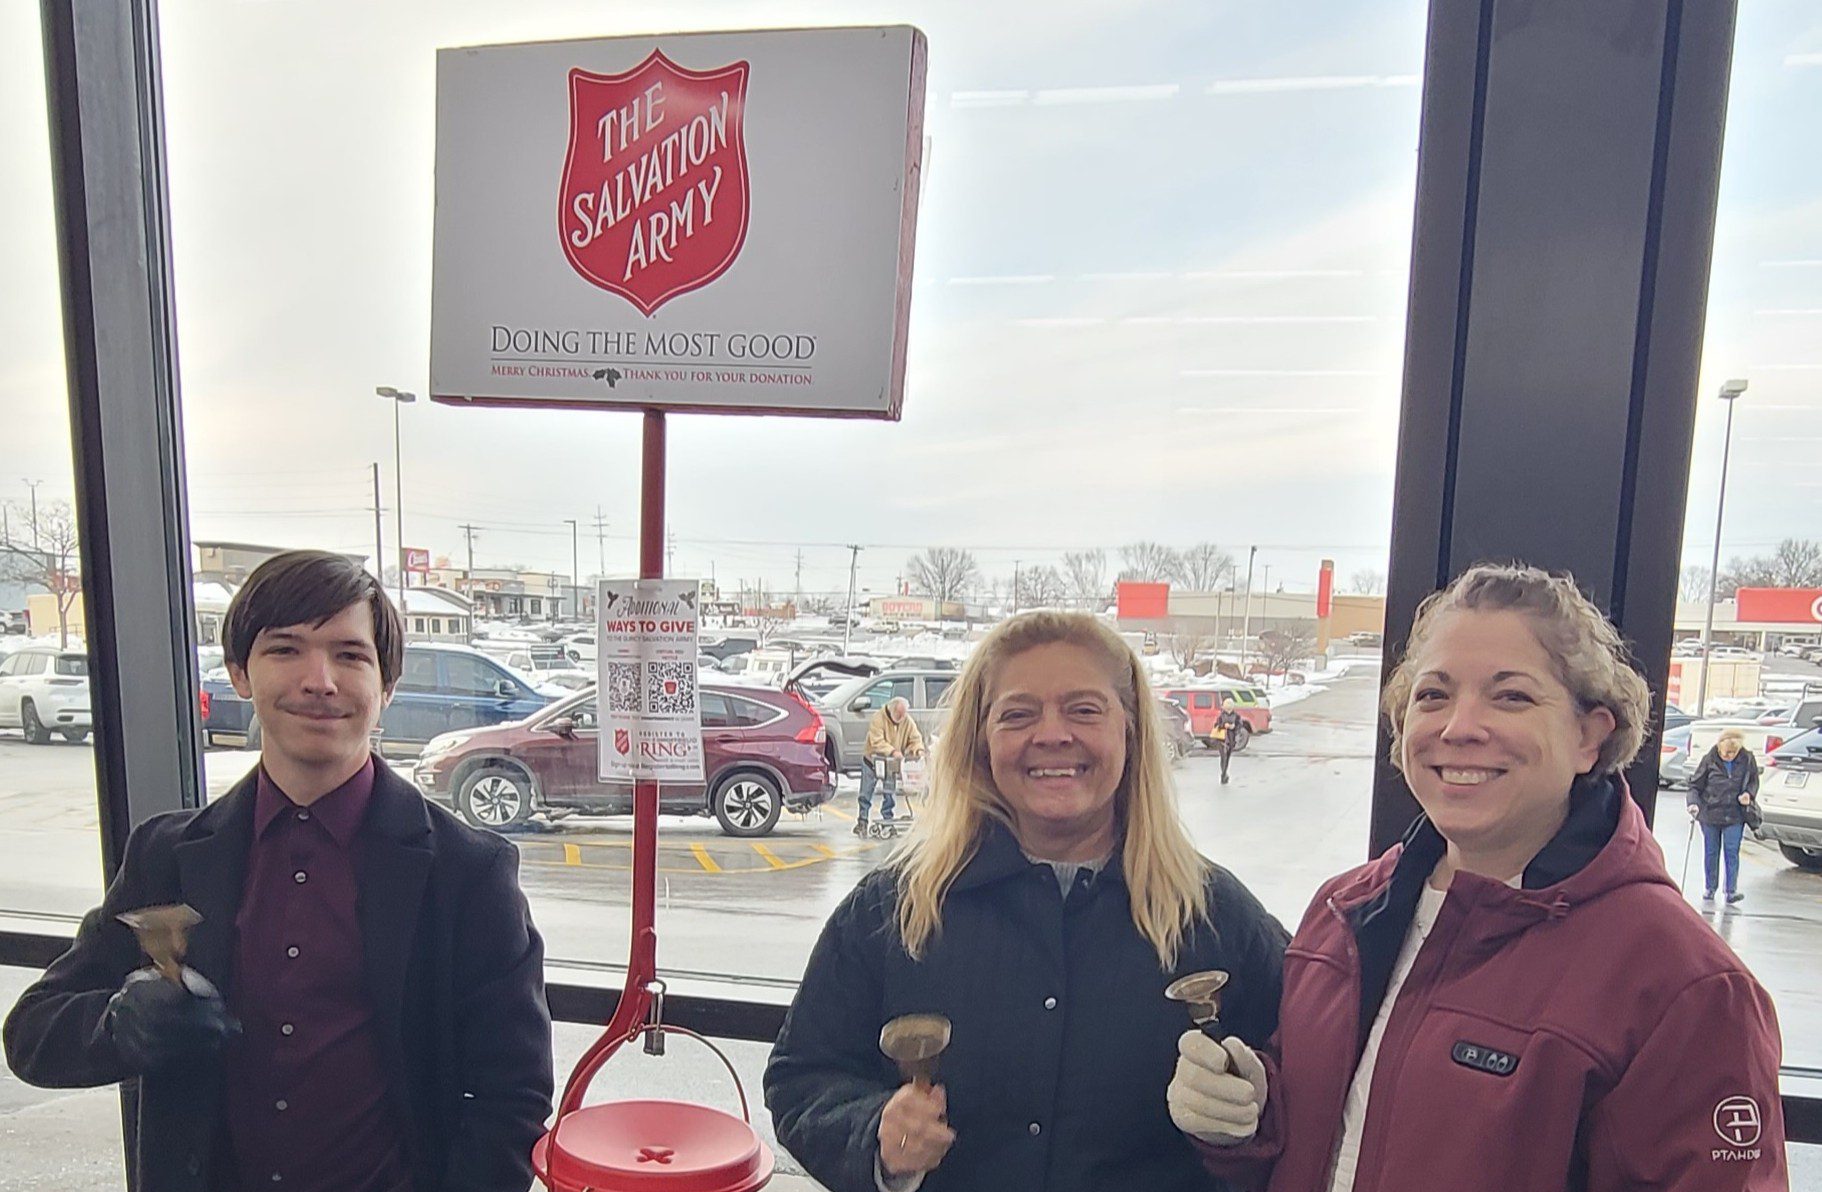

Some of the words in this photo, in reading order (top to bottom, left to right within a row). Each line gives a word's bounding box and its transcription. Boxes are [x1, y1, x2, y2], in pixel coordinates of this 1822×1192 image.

[597, 81, 667, 164] THE
[571, 91, 729, 248] SALVATION
[622, 165, 723, 283] ARMY
[491, 325, 580, 354] DOING
[586, 331, 637, 355] THE
[644, 332, 721, 358] MOST
[727, 333, 816, 360] GOOD
[491, 364, 526, 377] MERRY
[623, 367, 661, 381] THANK
[664, 370, 688, 382] YOU
[690, 371, 713, 383] FOR
[715, 372, 746, 384] YOUR
[749, 373, 813, 386] DONATION
[606, 620, 636, 633] WAYS
[639, 621, 656, 633] TO
[660, 621, 695, 633] GIVE
[640, 738, 688, 760] RING
